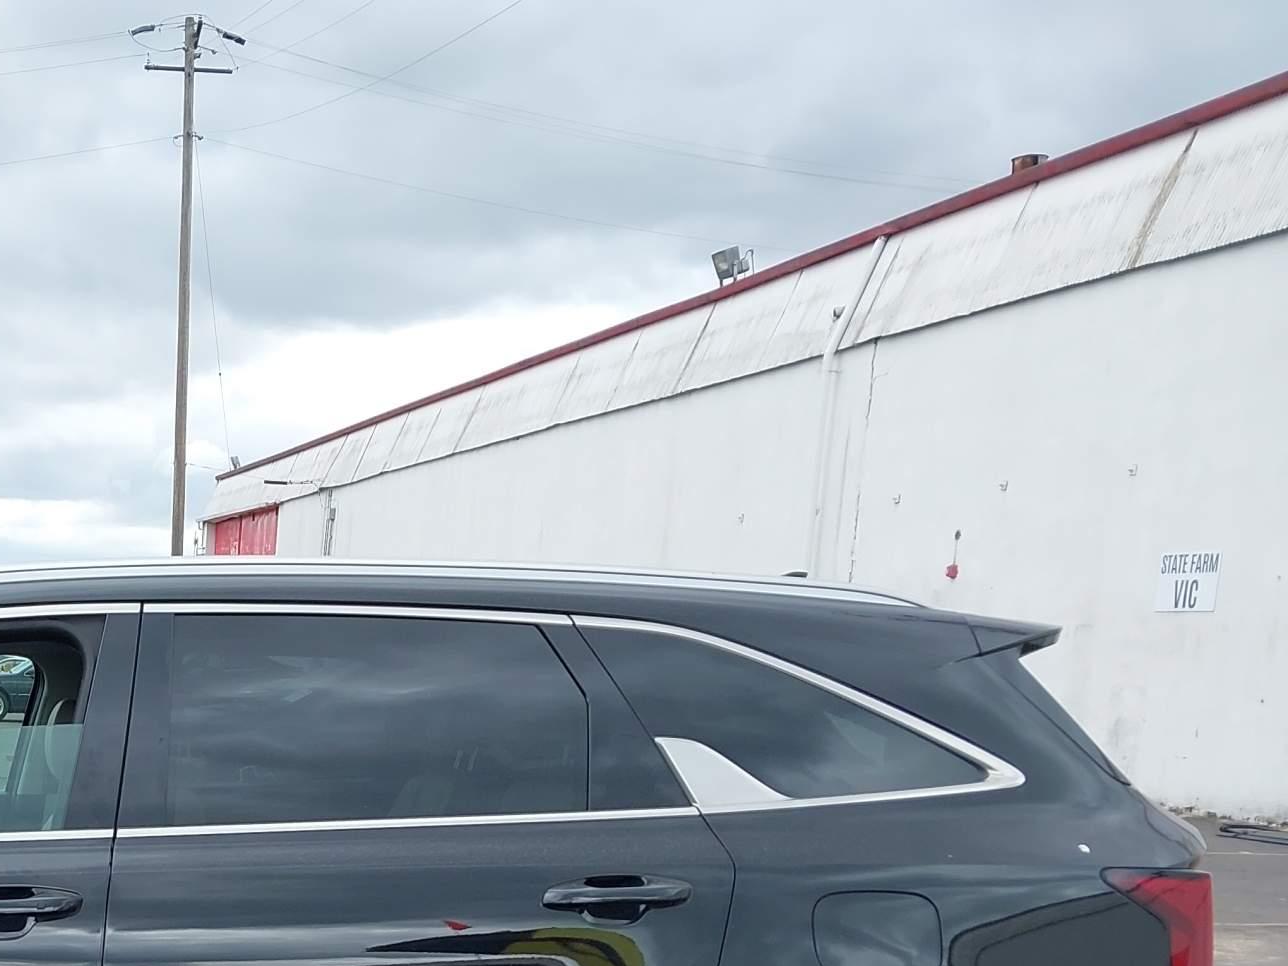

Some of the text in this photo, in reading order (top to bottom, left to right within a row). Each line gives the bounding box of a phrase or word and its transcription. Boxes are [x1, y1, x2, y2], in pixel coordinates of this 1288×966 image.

[1160, 552, 1220, 574] STATE FARM
[1174, 579, 1199, 609] VIC
